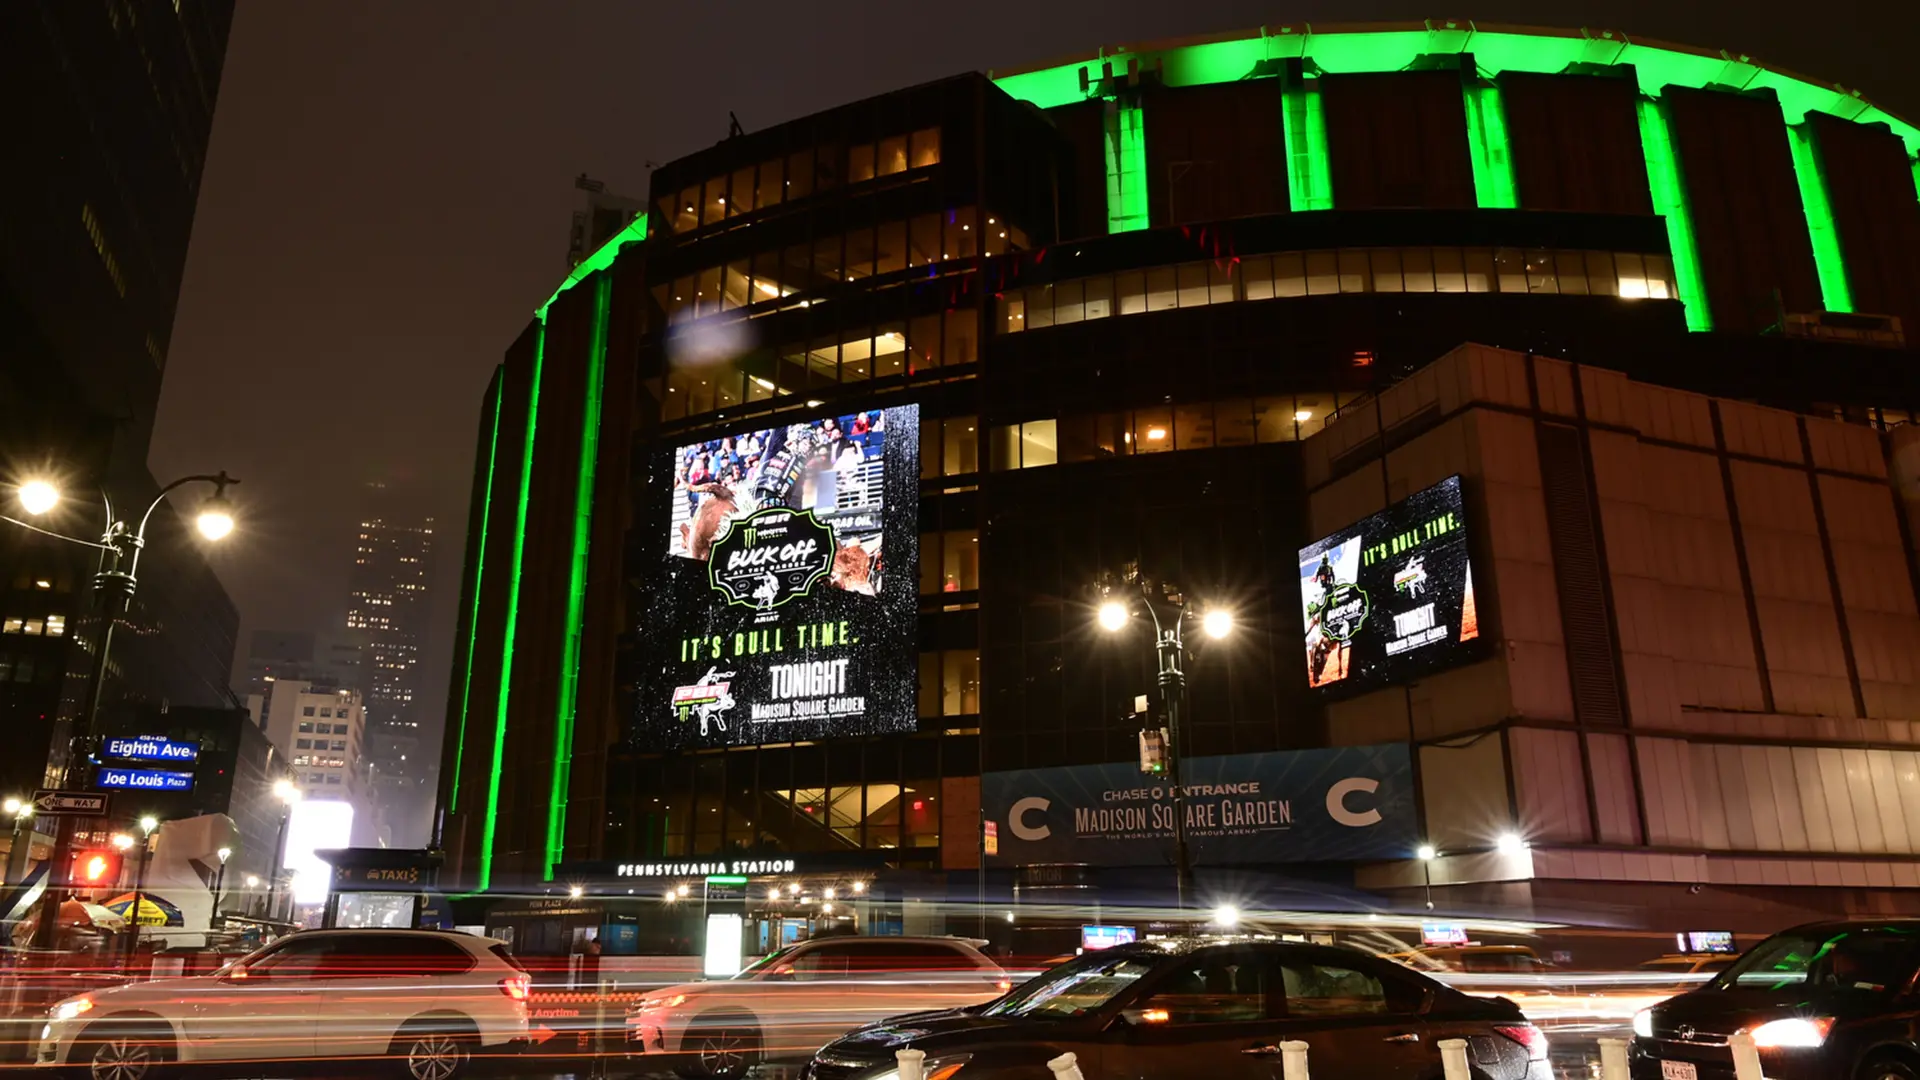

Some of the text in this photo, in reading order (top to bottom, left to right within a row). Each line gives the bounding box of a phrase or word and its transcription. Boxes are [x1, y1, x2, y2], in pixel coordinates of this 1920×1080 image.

[1363, 512, 1460, 567] IT'S BULL TIME.
[727, 545, 780, 571] BUCK
[754, 614, 780, 624] ARIAT
[682, 621, 860, 662] IT'S BULL TIME.
[769, 658, 849, 700] TONIGHT
[752, 703, 791, 720] MADISON
[792, 700, 827, 717] SQUARE
[110, 740, 190, 757] Eighth Ave
[104, 772, 186, 786] Joe Louis Plaza
[44, 798, 95, 808] ONE WAY
[1103, 788, 1149, 802] CHASE
[1326, 777, 1382, 827] C
[1008, 796, 1051, 841] C
[1075, 799, 1290, 833] MADISON SQARE GARDEN
[381, 869, 408, 880] TAXI
[618, 860, 795, 876] PENNSYLVANIA STATION
[534, 1008, 579, 1018] Anytime
